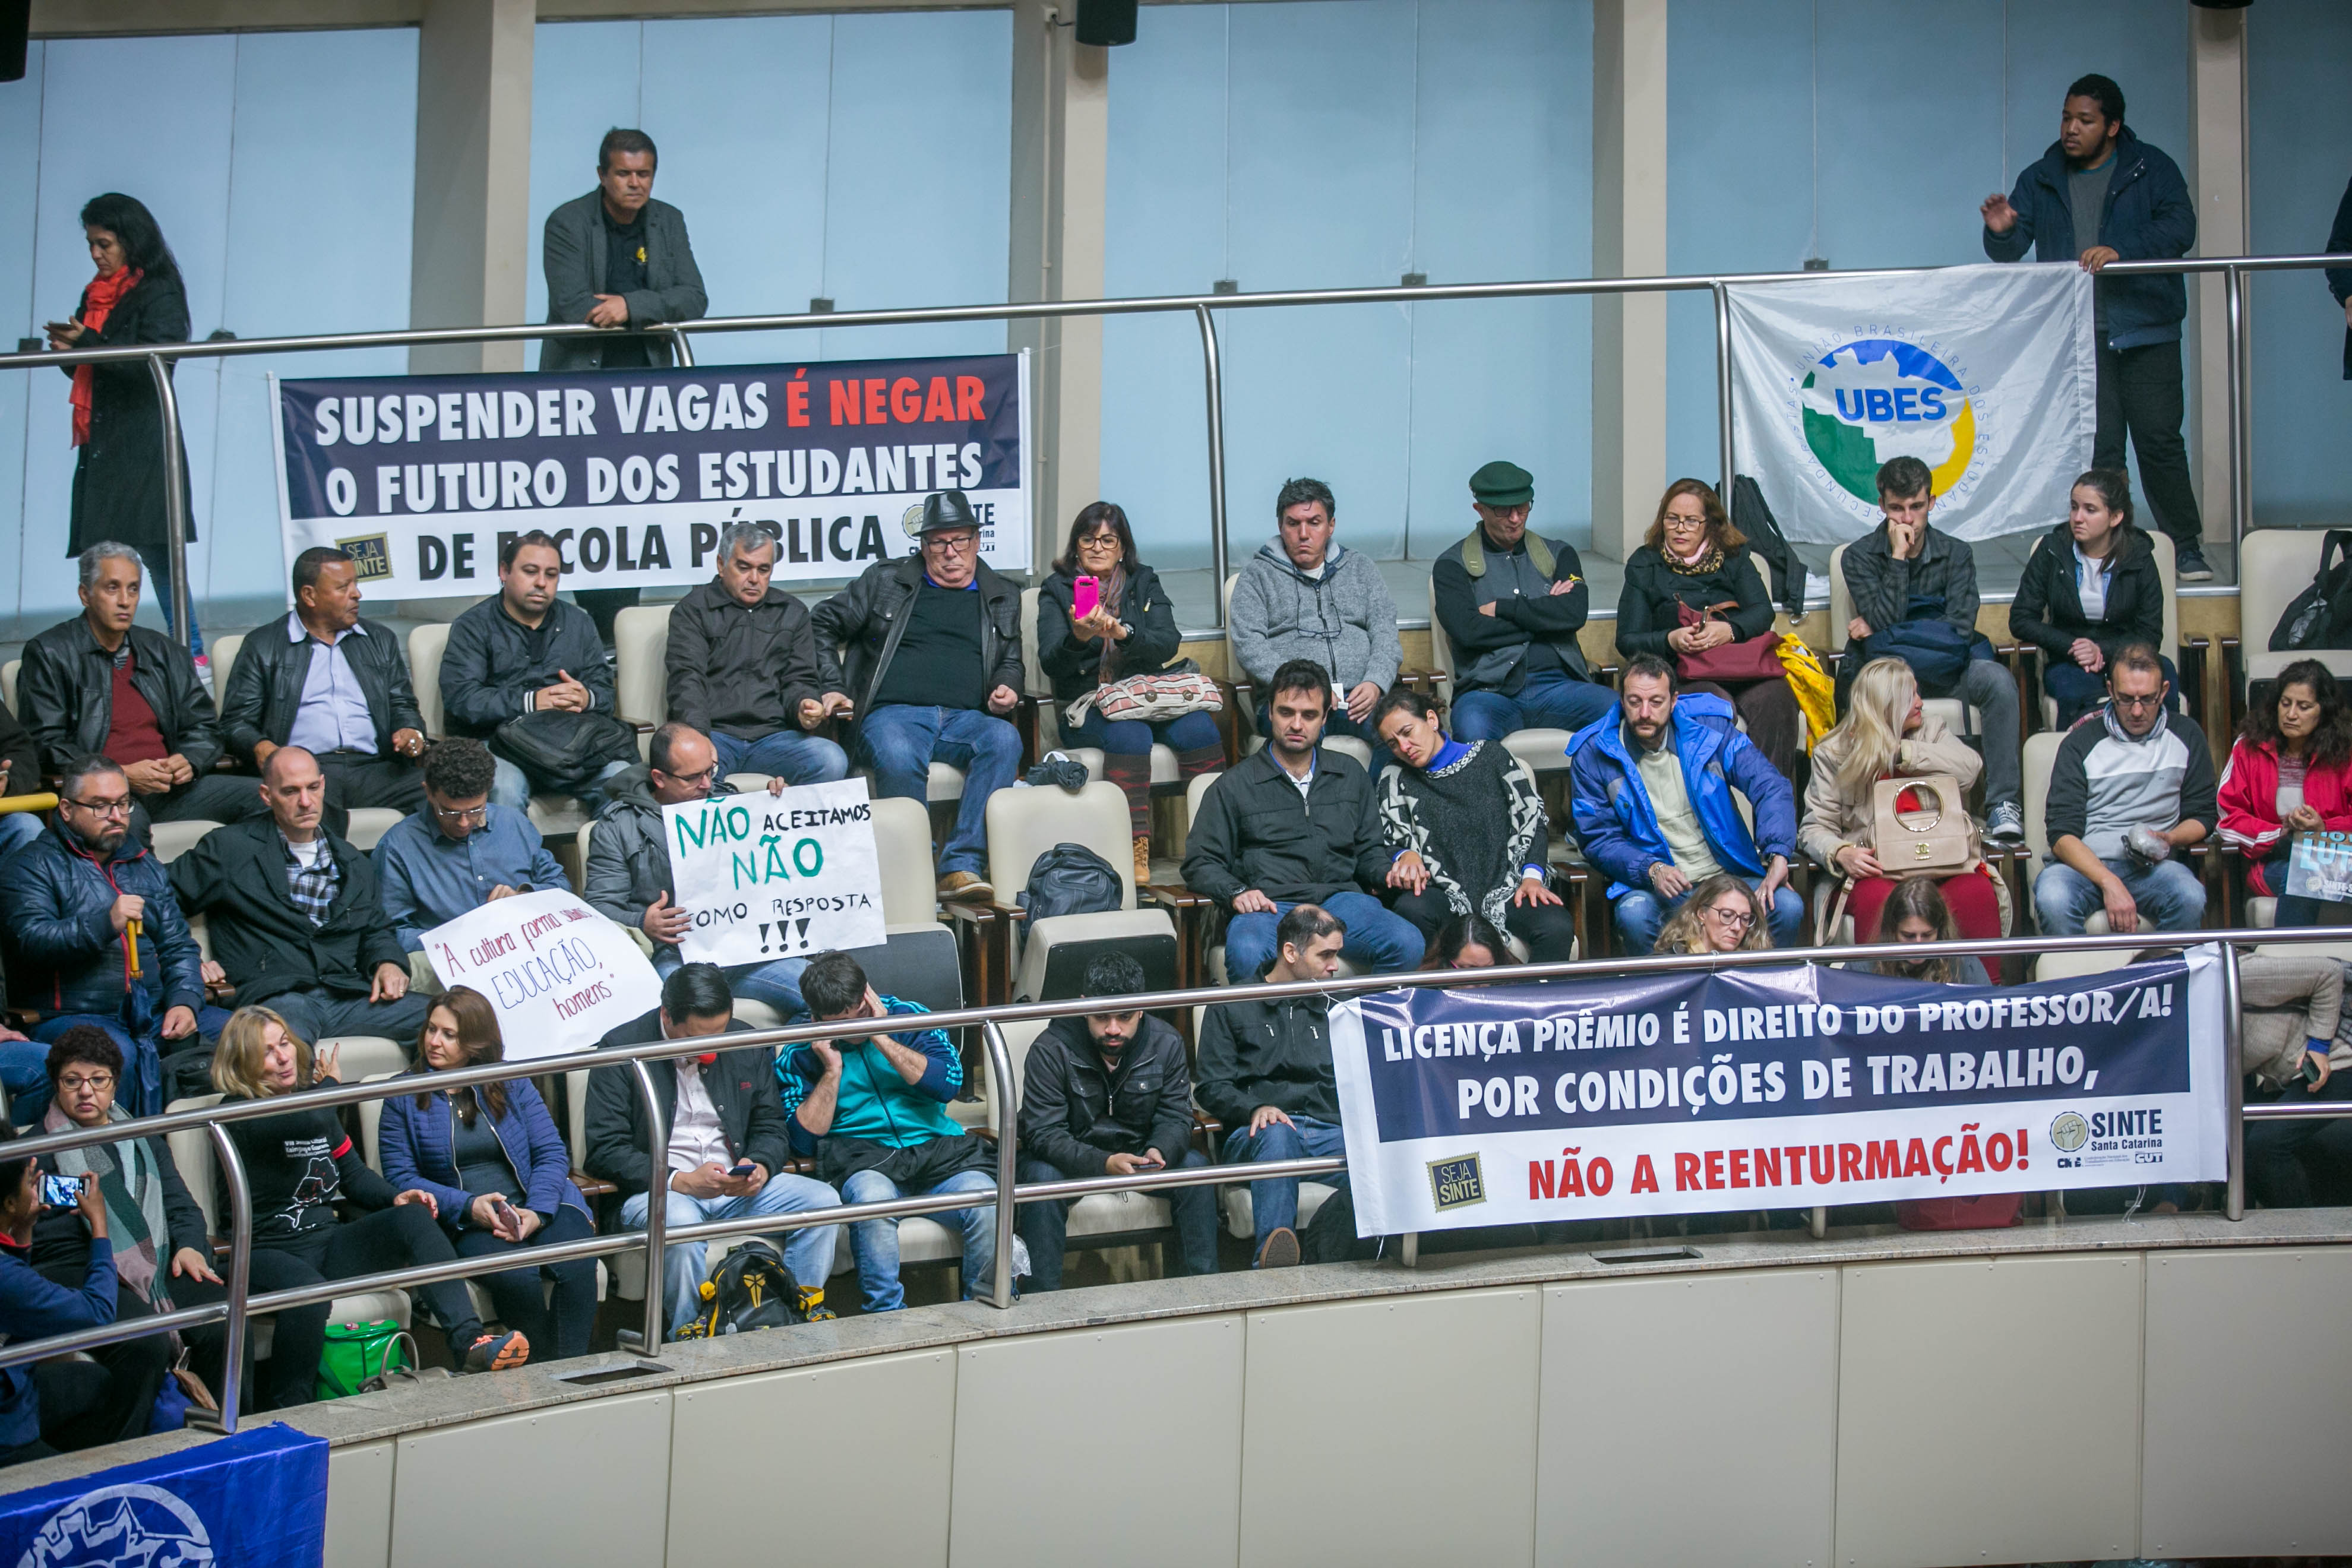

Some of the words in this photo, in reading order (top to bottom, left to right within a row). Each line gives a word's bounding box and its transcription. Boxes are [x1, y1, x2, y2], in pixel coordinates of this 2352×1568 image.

[1795, 333, 1842, 371] UNIÃO
[1854, 324, 1967, 377] BRASILEIRA
[315, 388, 598, 446] SUSPENDER
[612, 381, 769, 434] VAGAS
[786, 368, 810, 428] É
[830, 375, 986, 426] NEGAR
[1835, 387, 1947, 422] UBES
[1969, 385, 1989, 422] DOS
[325, 467, 357, 516] O
[377, 459, 567, 513] FUTURO
[587, 454, 680, 504] DOS
[698, 442, 983, 500] ESTUDANTES
[1929, 434, 1989, 515] ESTUDAN
[347, 542, 379, 561] SEJA
[354, 556, 387, 576] INTE
[418, 533, 475, 581] DE
[497, 524, 672, 577] ECOLA
[675, 796, 750, 859] NÃO
[763, 803, 871, 832] ACEITAMOS
[732, 834, 824, 890] NÃO
[2300, 838, 2352, 873] LUT
[688, 903, 748, 929] OMO
[772, 893, 872, 916] RESPOSTA
[470, 933, 517, 966] cultura
[521, 913, 562, 951] forma
[491, 937, 603, 1009] EDUCAÇÃO,
[1382, 1020, 1521, 1062] LICENÇA
[1533, 1009, 1660, 1052] PRÊMIO
[1673, 1001, 1690, 1044] É
[1703, 1004, 1842, 1042] DIREITO
[1855, 1005, 1905, 1035] DO
[1918, 984, 2173, 1032] PROFESSOR/A!
[1458, 1075, 1541, 1120] POR
[1554, 1053, 1786, 1116] CONDIÇÕES
[1801, 1057, 1852, 1100] DE
[1867, 1045, 2099, 1095] TRABALHO,
[2091, 1109, 2162, 1138] SINTE
[2091, 1141, 2118, 1151] Santa
[2122, 1138, 2162, 1149] Catarina
[1441, 1162, 1472, 1184] SEJA
[1529, 1146, 1614, 1200] NÃO
[1630, 1154, 1660, 1194] A
[1674, 1123, 2029, 1192] REENTURMAÇÃO!
[2135, 1153, 2163, 1164] CUT
[1440, 1178, 1480, 1203] SINTE
